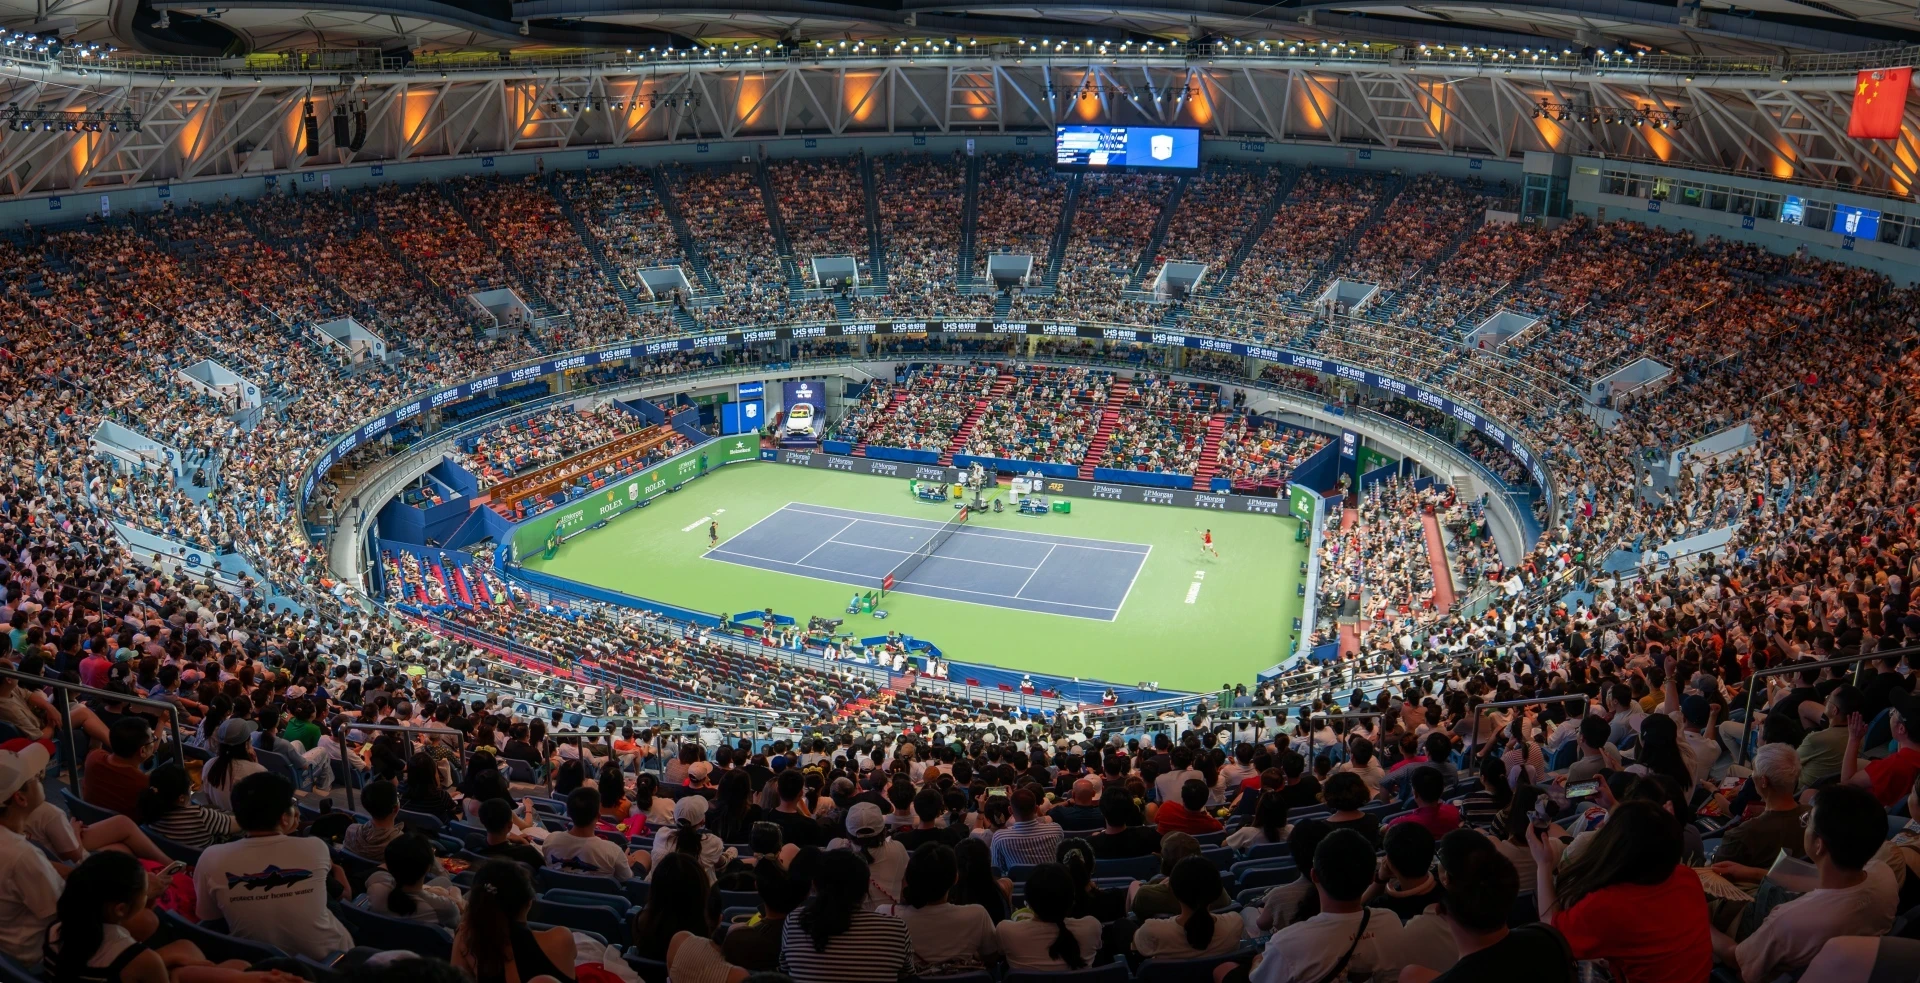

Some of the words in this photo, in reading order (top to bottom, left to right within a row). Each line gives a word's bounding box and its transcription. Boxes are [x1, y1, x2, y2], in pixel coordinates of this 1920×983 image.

[1524, 215, 1535, 223] 02A
[1743, 218, 1754, 227] 01A
[729, 446, 751, 455] Heineken
[645, 478, 666, 494] ROLEX
[600, 498, 623, 515] ROLEX
[229, 894, 253, 904] protect
[254, 893, 269, 901] our
[270, 891, 292, 900] home
[294, 888, 314, 897] water
